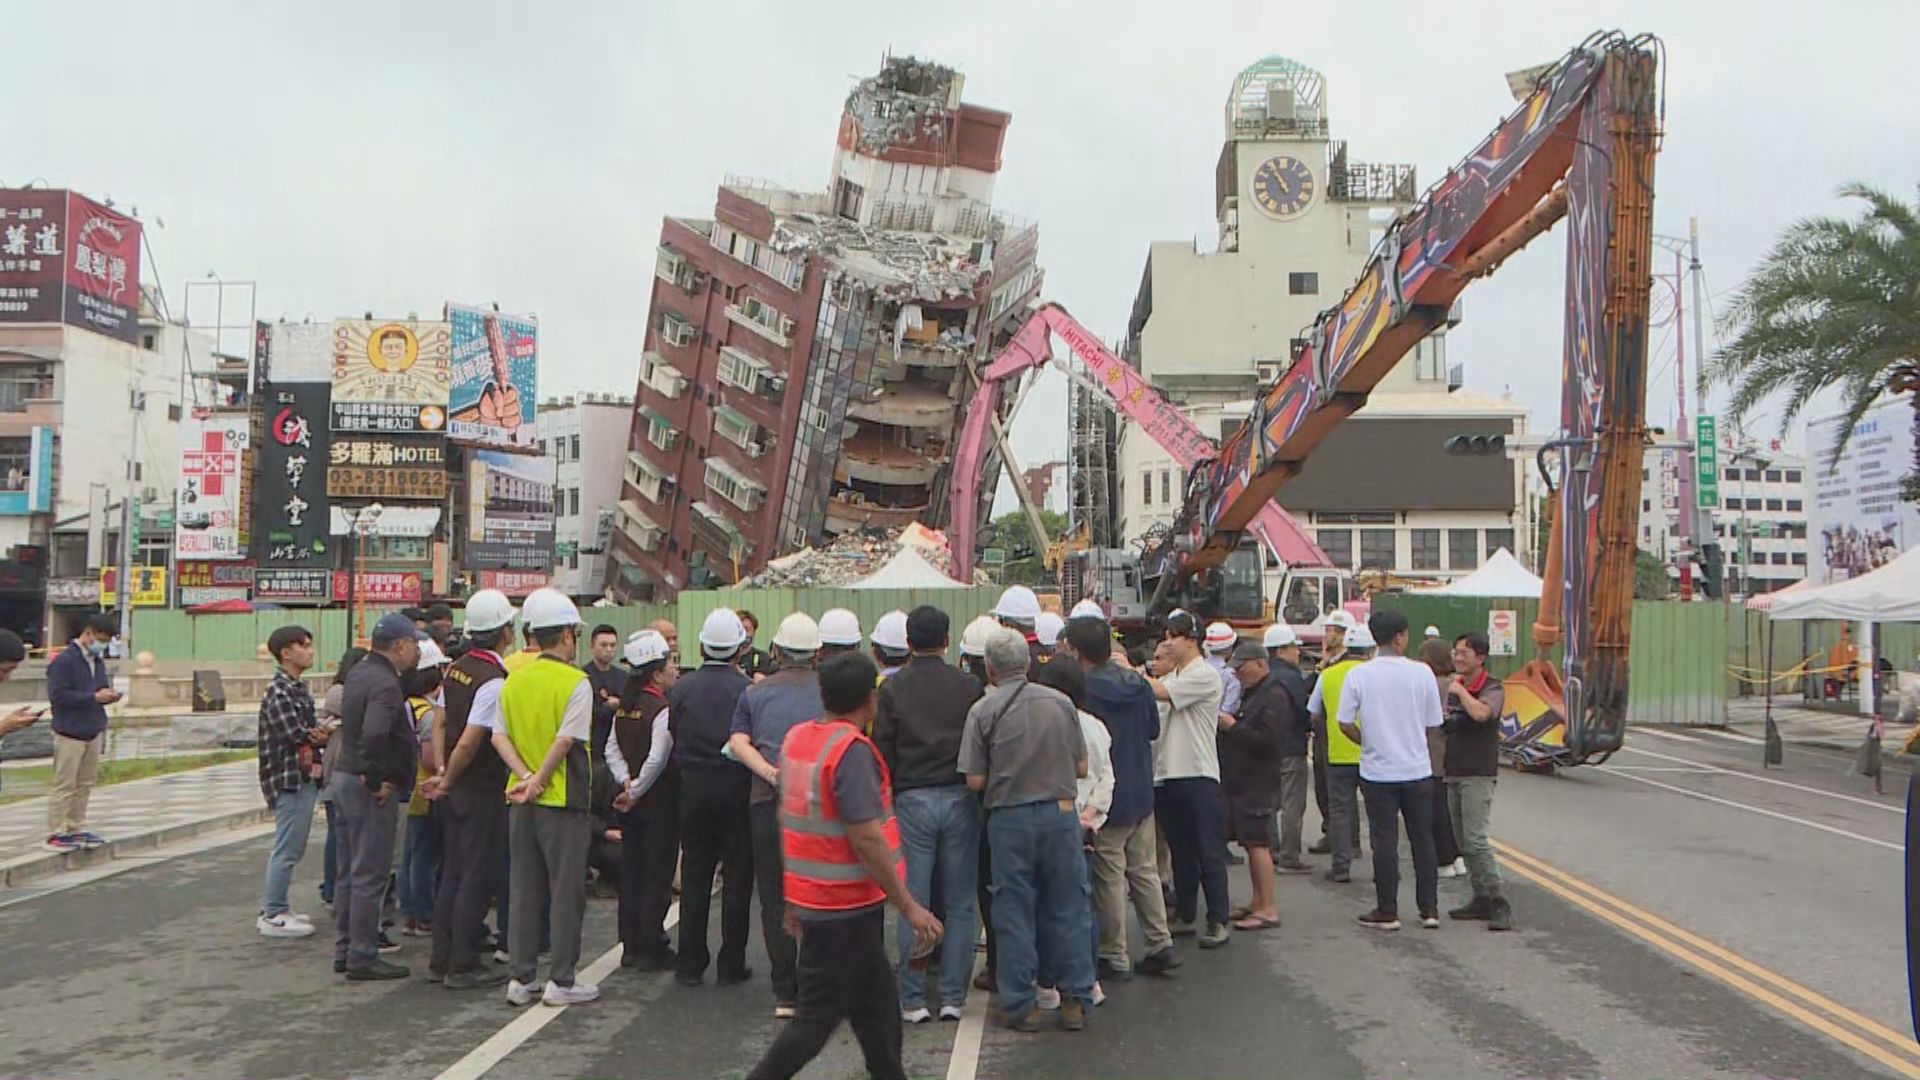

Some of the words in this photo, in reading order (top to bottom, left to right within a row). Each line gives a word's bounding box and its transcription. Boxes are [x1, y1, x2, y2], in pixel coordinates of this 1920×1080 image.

[1064, 328, 1104, 369] HITACHI
[329, 441, 393, 466] 多羅滿
[394, 447, 444, 462] HOTEL
